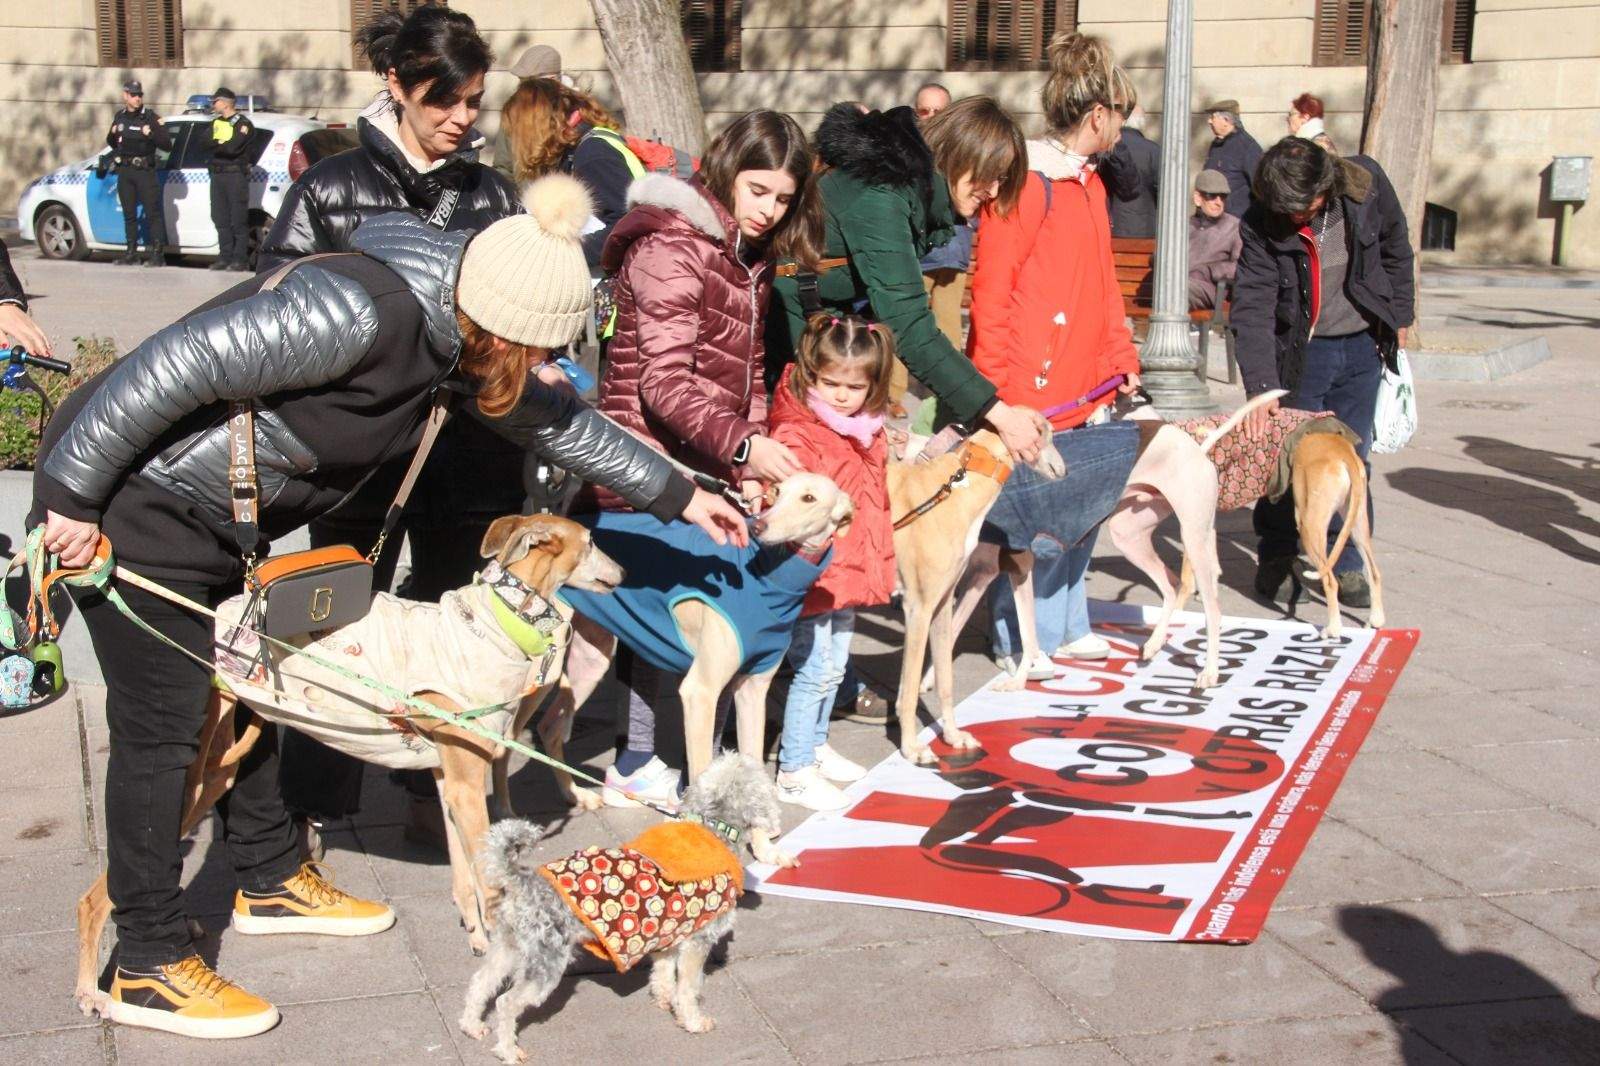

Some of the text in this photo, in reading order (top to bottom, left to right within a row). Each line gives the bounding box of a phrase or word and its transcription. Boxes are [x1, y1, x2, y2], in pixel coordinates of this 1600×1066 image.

[234, 402, 246, 426] RC
[1036, 704, 1099, 722] LA
[1056, 627, 1269, 786] CON GALGOS
[1191, 632, 1353, 794] Y OTRAS RAZAS
[1021, 726, 1074, 738] A
[1228, 846, 1271, 887] indefensa
